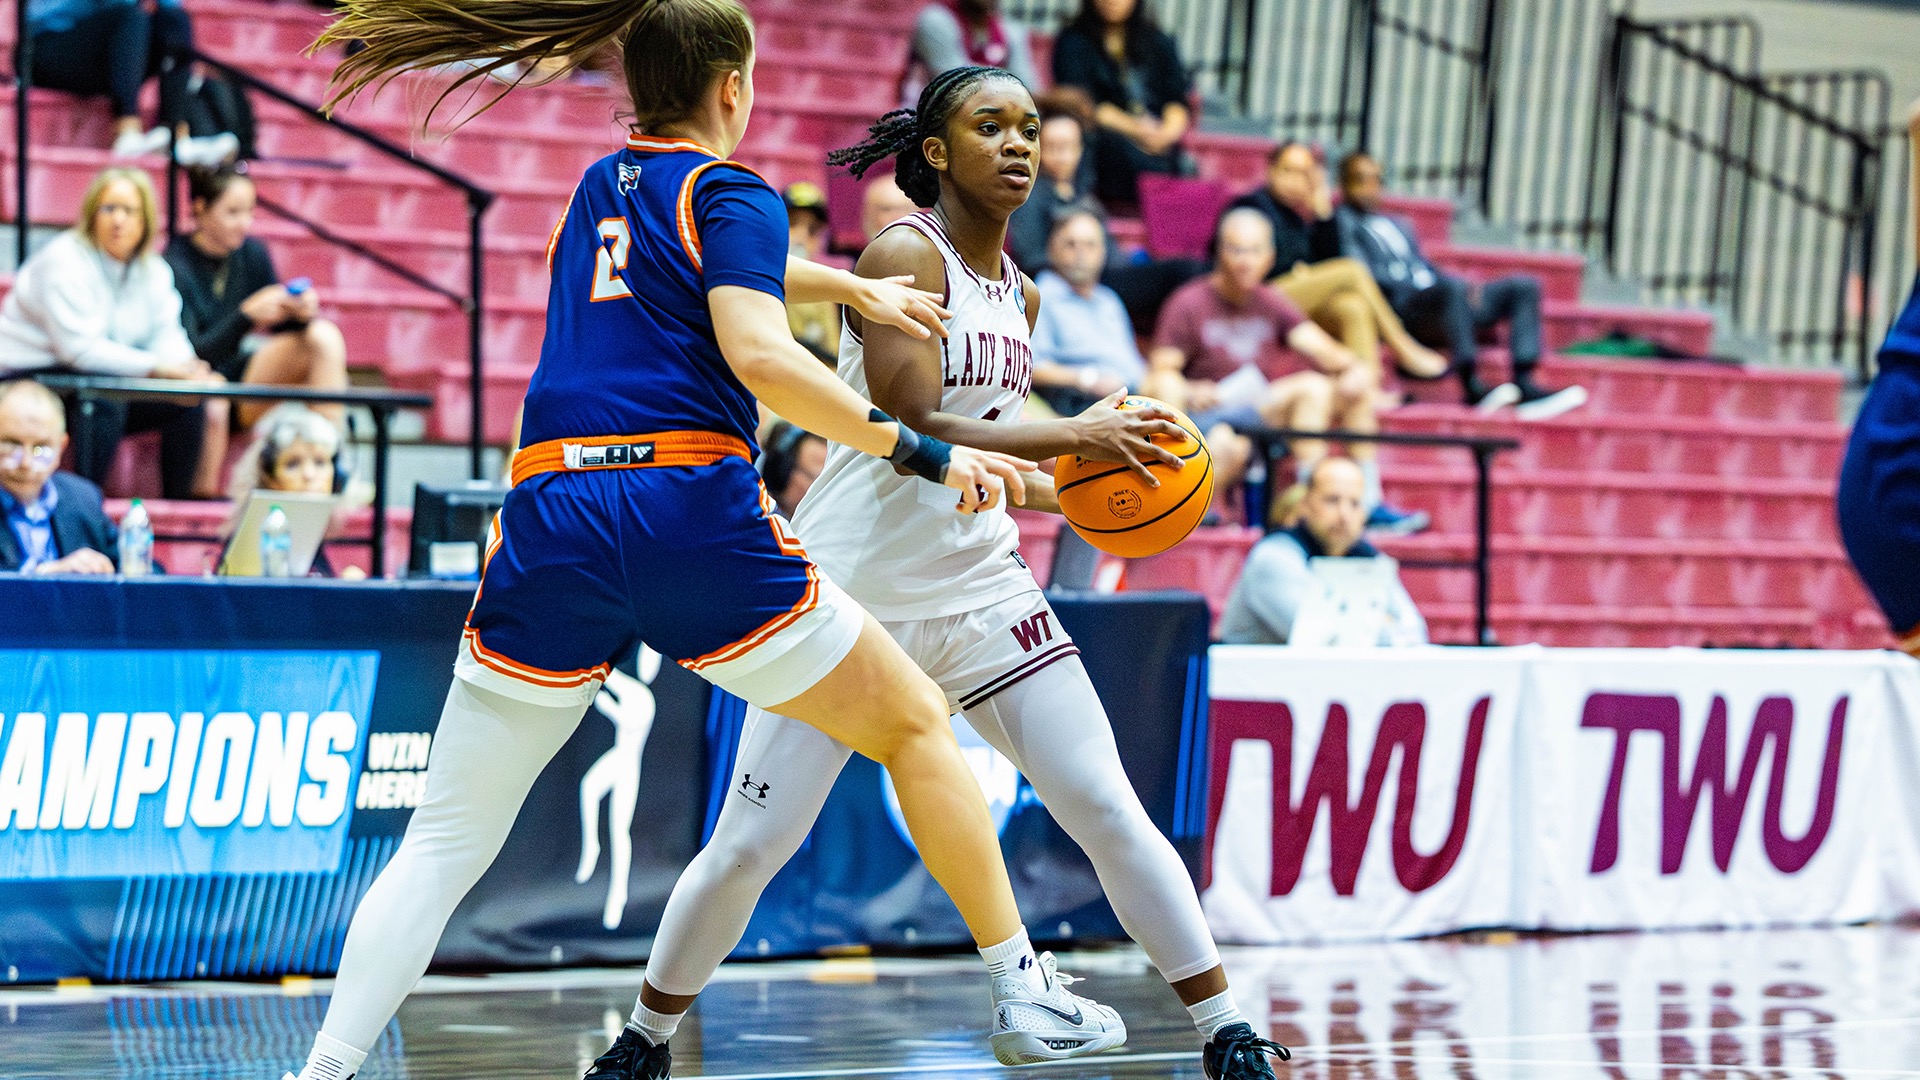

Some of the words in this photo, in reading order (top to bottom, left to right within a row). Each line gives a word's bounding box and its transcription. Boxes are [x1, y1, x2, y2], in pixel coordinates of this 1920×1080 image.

[589, 216, 635, 303] 2
[942, 331, 996, 387] LADY
[1010, 610, 1053, 653] WT
[0, 710, 357, 830] AMPIONS
[368, 731, 432, 770] WIN
[1580, 693, 1849, 875] TWU
[355, 770, 428, 810] HERE
[1202, 696, 1491, 896] TWU
